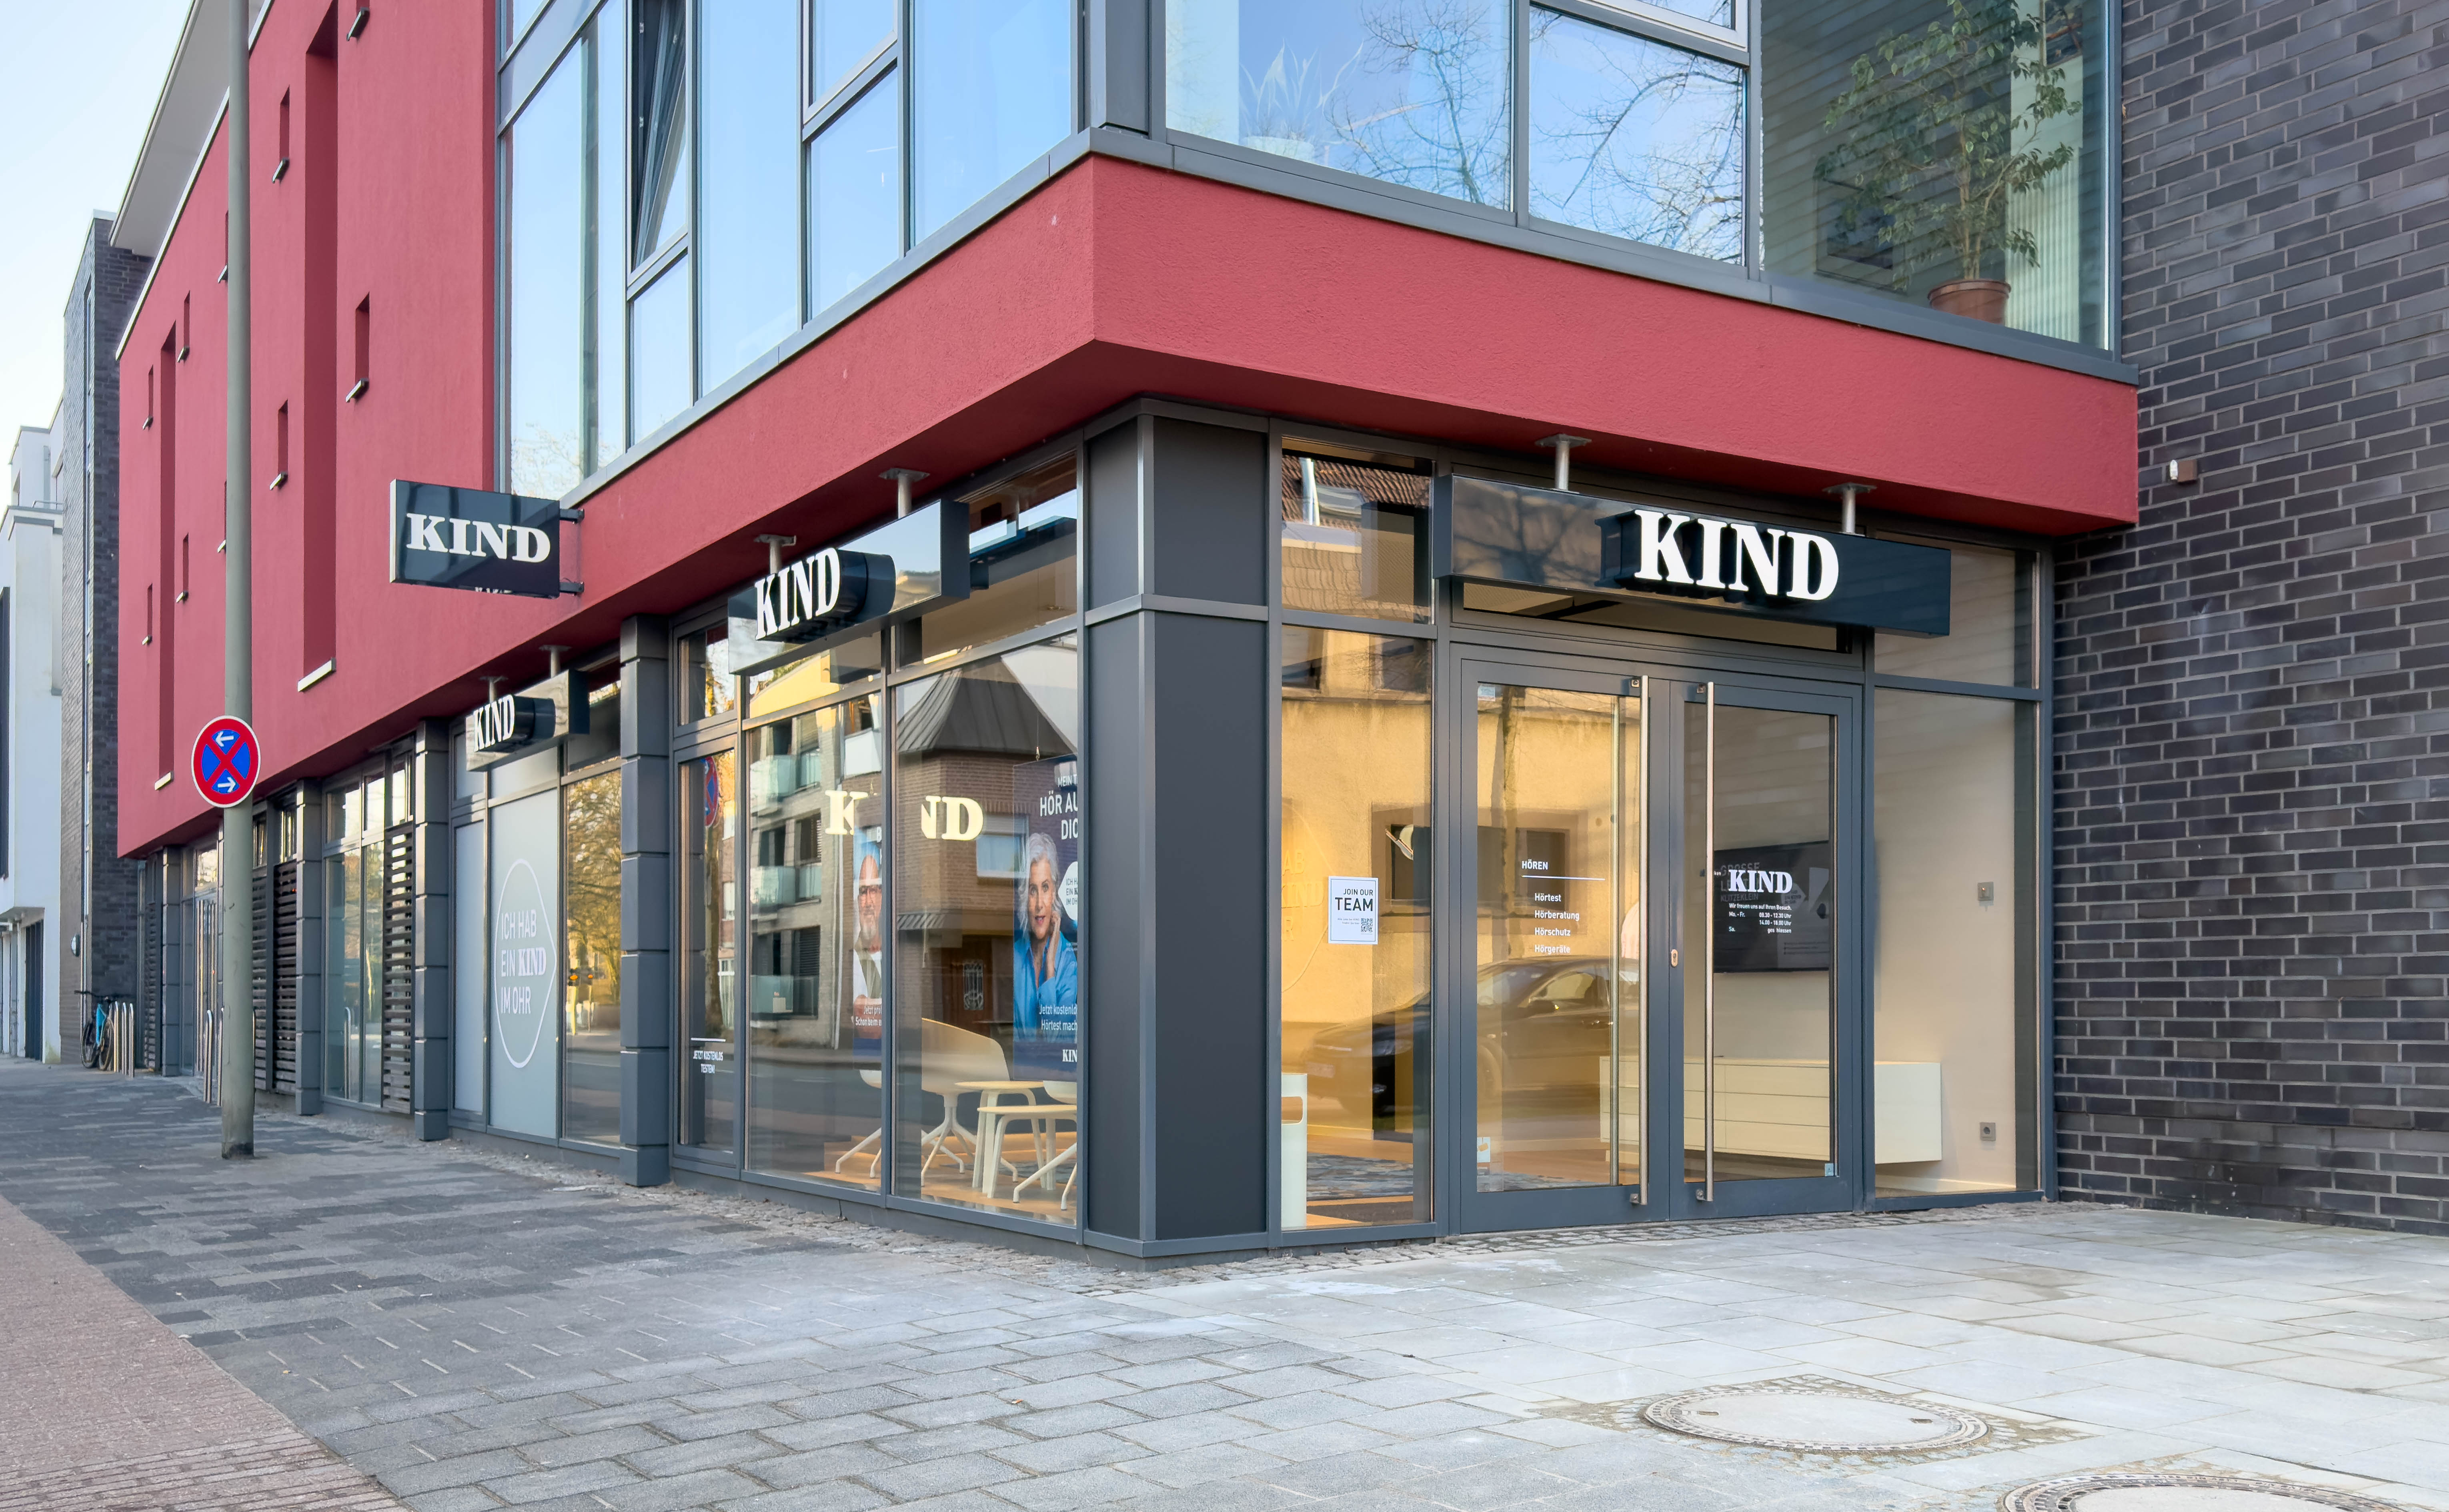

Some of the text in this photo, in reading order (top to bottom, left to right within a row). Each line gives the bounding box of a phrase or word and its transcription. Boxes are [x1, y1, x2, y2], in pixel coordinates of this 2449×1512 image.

[406, 513, 551, 563] KIND
[1634, 509, 1839, 601] KIND
[755, 547, 840, 640] KIND
[473, 694, 515, 752] KIND
[1058, 775, 1072, 787] MEIN
[1040, 790, 1062, 817] HÖR
[1522, 859, 1548, 870] HÖREN
[1728, 869, 1792, 893] KIND
[1535, 893, 1561, 902] Hörtest
[1335, 897, 1373, 911] TEAM
[1535, 910, 1580, 921] Hörberatung
[501, 909, 537, 939] ICH HAB
[1535, 927, 1571, 936] Hörschutz
[1535, 945, 1570, 955] Hörgeräte
[501, 947, 547, 977] EIN KIND
[501, 986, 531, 1014] IM OHR
[864, 1005, 873, 1014] Jetzt
[1039, 1004, 1052, 1015] Jetzt
[855, 1016, 867, 1025] Schon
[868, 1017, 878, 1026] beim
[1041, 1019, 1061, 1030] Hörtest
[693, 1050, 723, 1061] JETZT KOSTENLOS
[701, 1063, 715, 1074] TESTEN!
